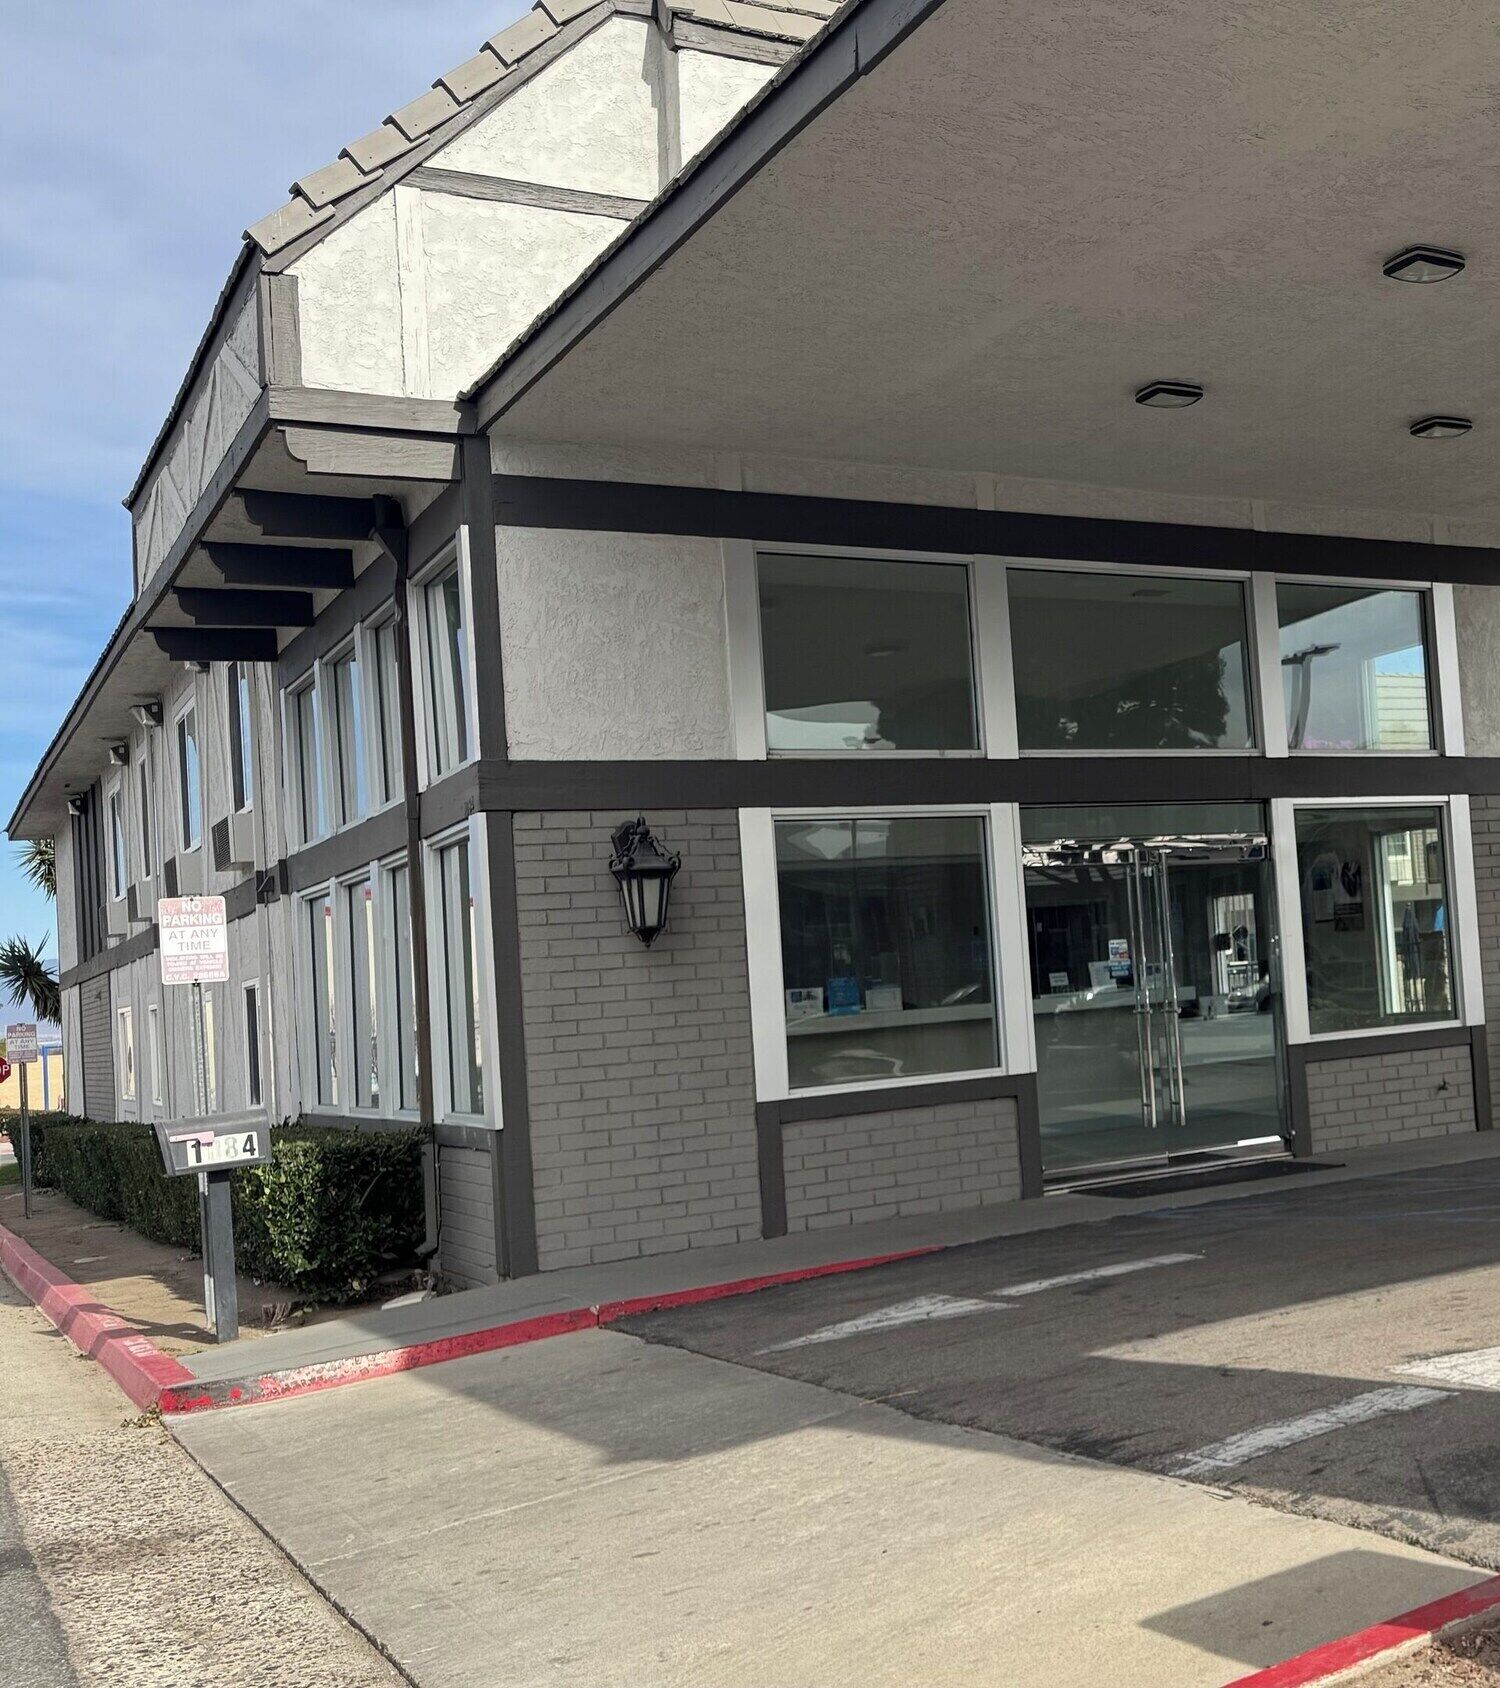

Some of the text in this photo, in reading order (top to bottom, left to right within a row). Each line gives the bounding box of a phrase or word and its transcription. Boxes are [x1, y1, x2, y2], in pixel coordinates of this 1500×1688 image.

[181, 901, 202, 912] NO
[162, 913, 222, 927] PARKING
[168, 928, 218, 940] AT ANY
[177, 941, 211, 952] TIME
